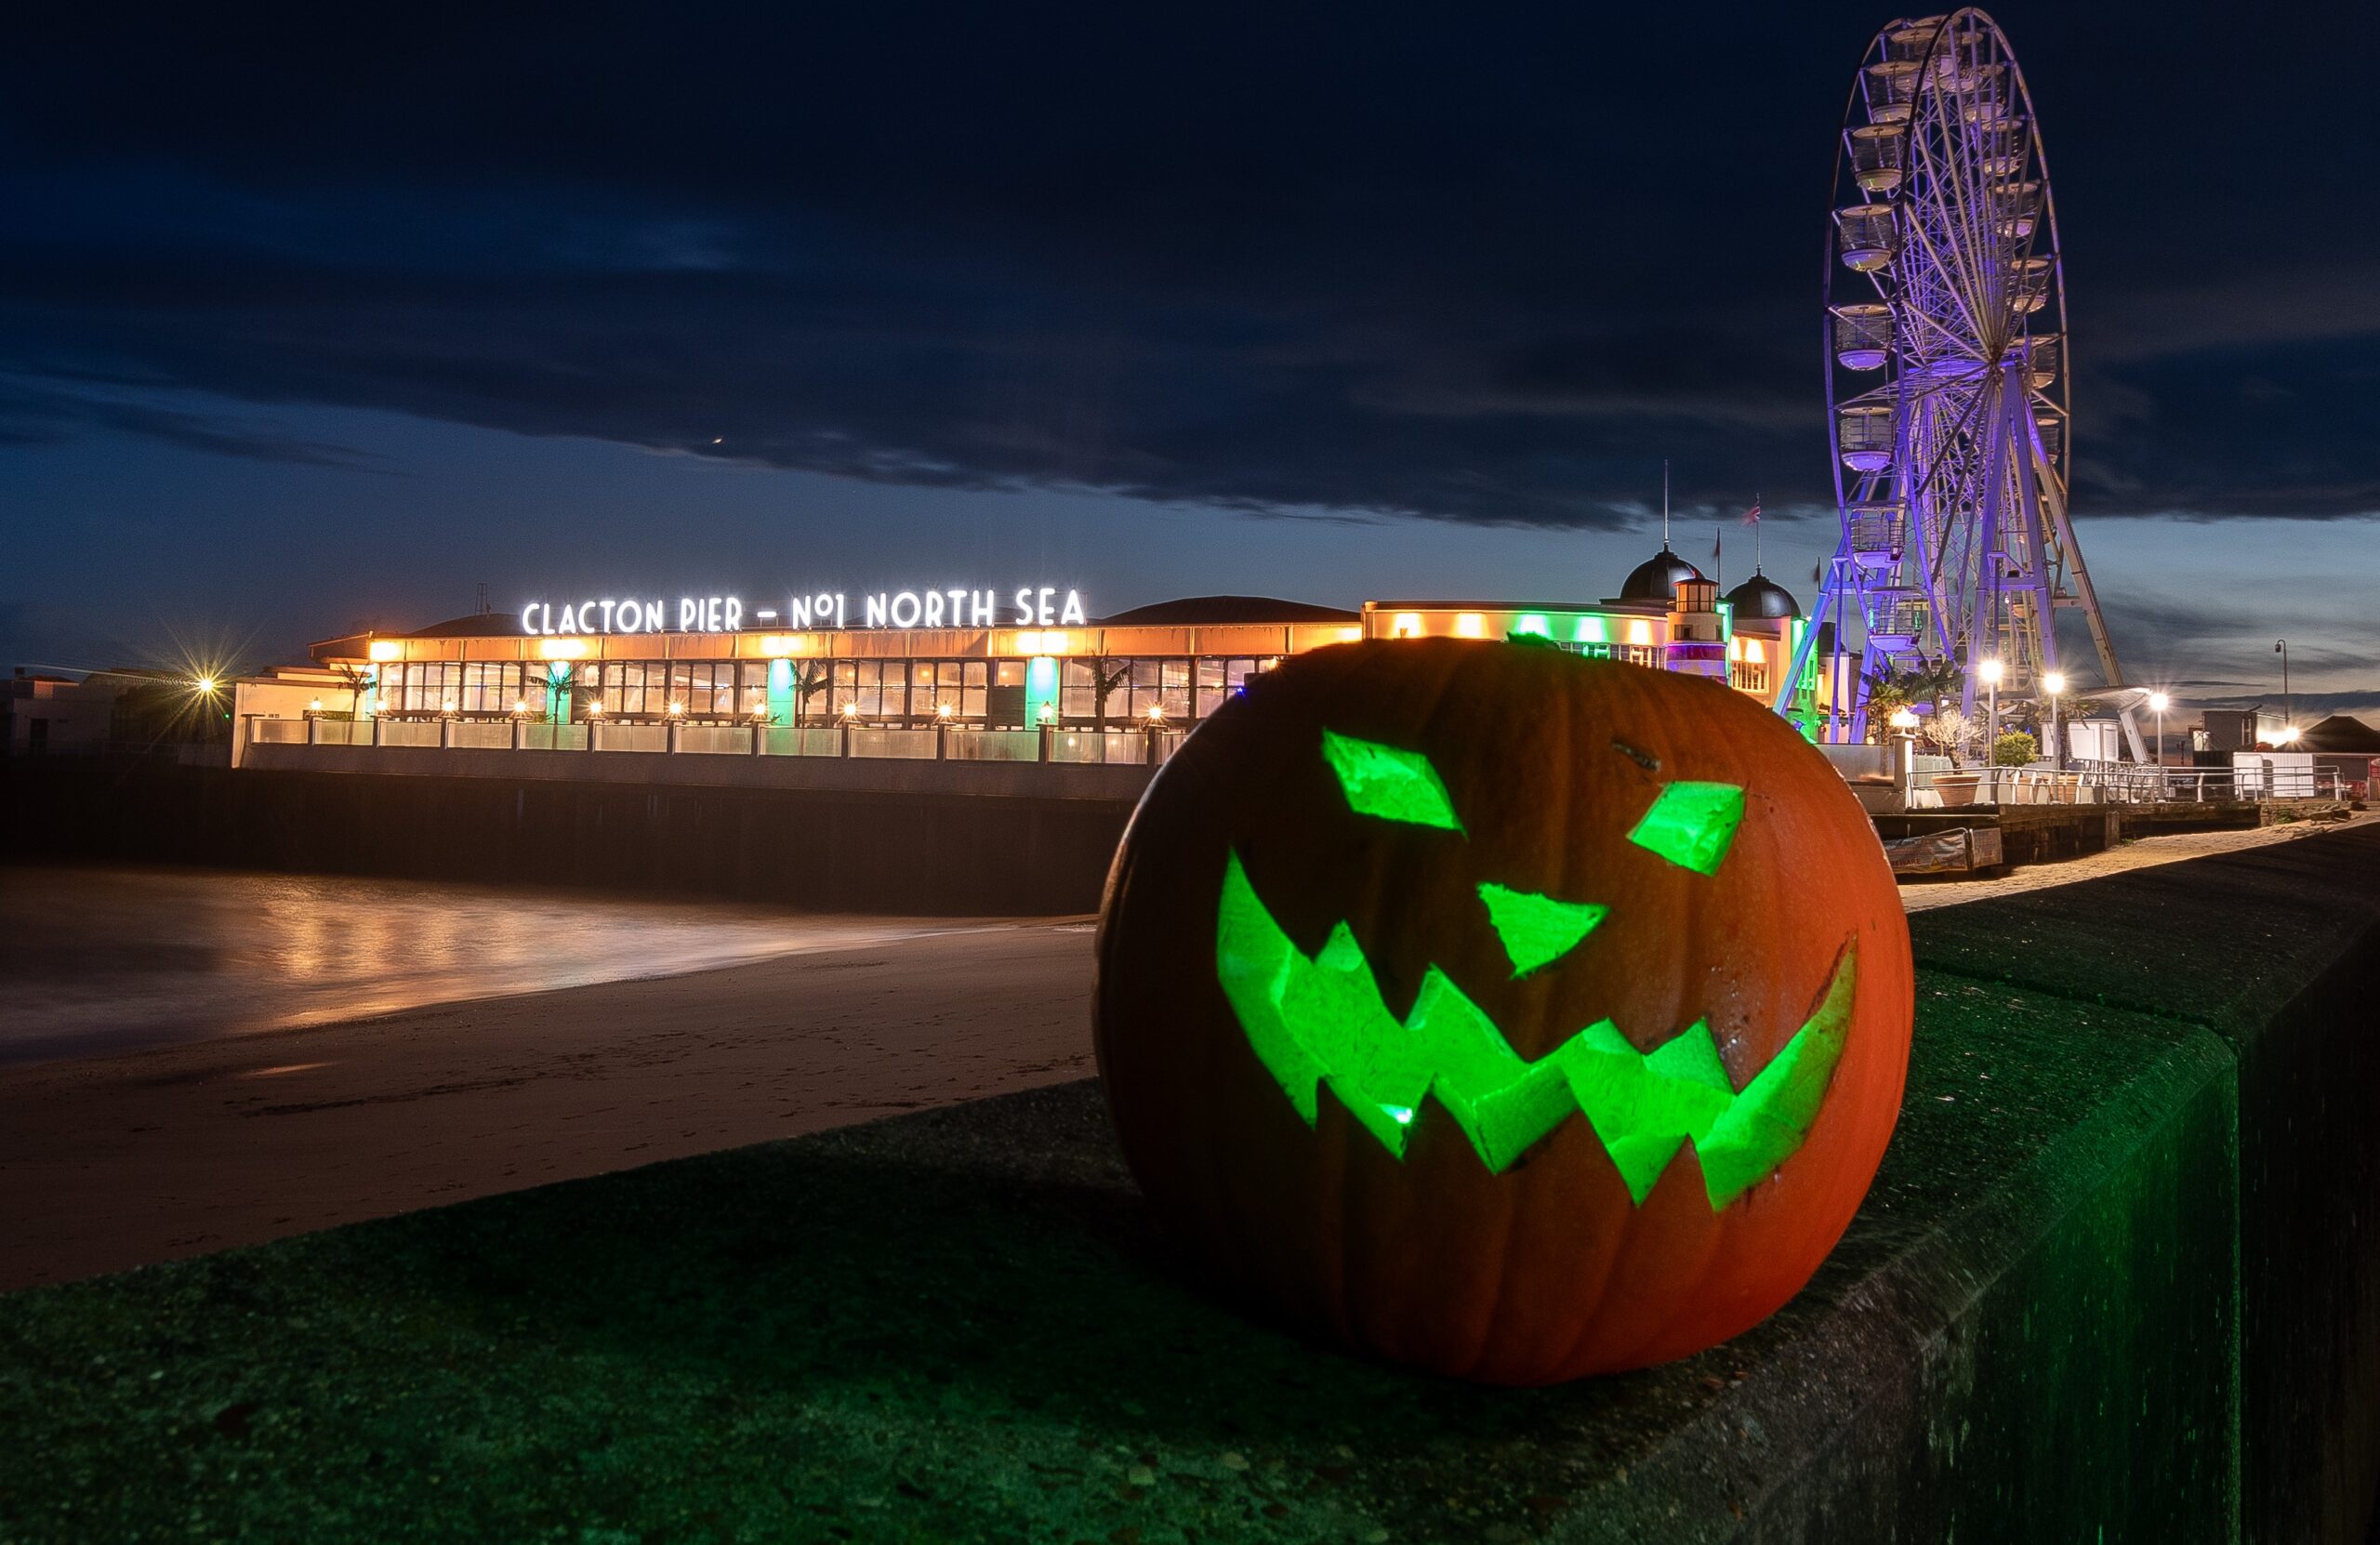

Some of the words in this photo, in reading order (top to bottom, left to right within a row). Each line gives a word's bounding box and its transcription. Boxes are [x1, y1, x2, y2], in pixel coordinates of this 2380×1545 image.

[522, 600, 664, 635] CLACTON
[680, 598, 743, 633] PIER
[866, 589, 995, 628] NORTH
[1015, 588, 1085, 626] SEA
